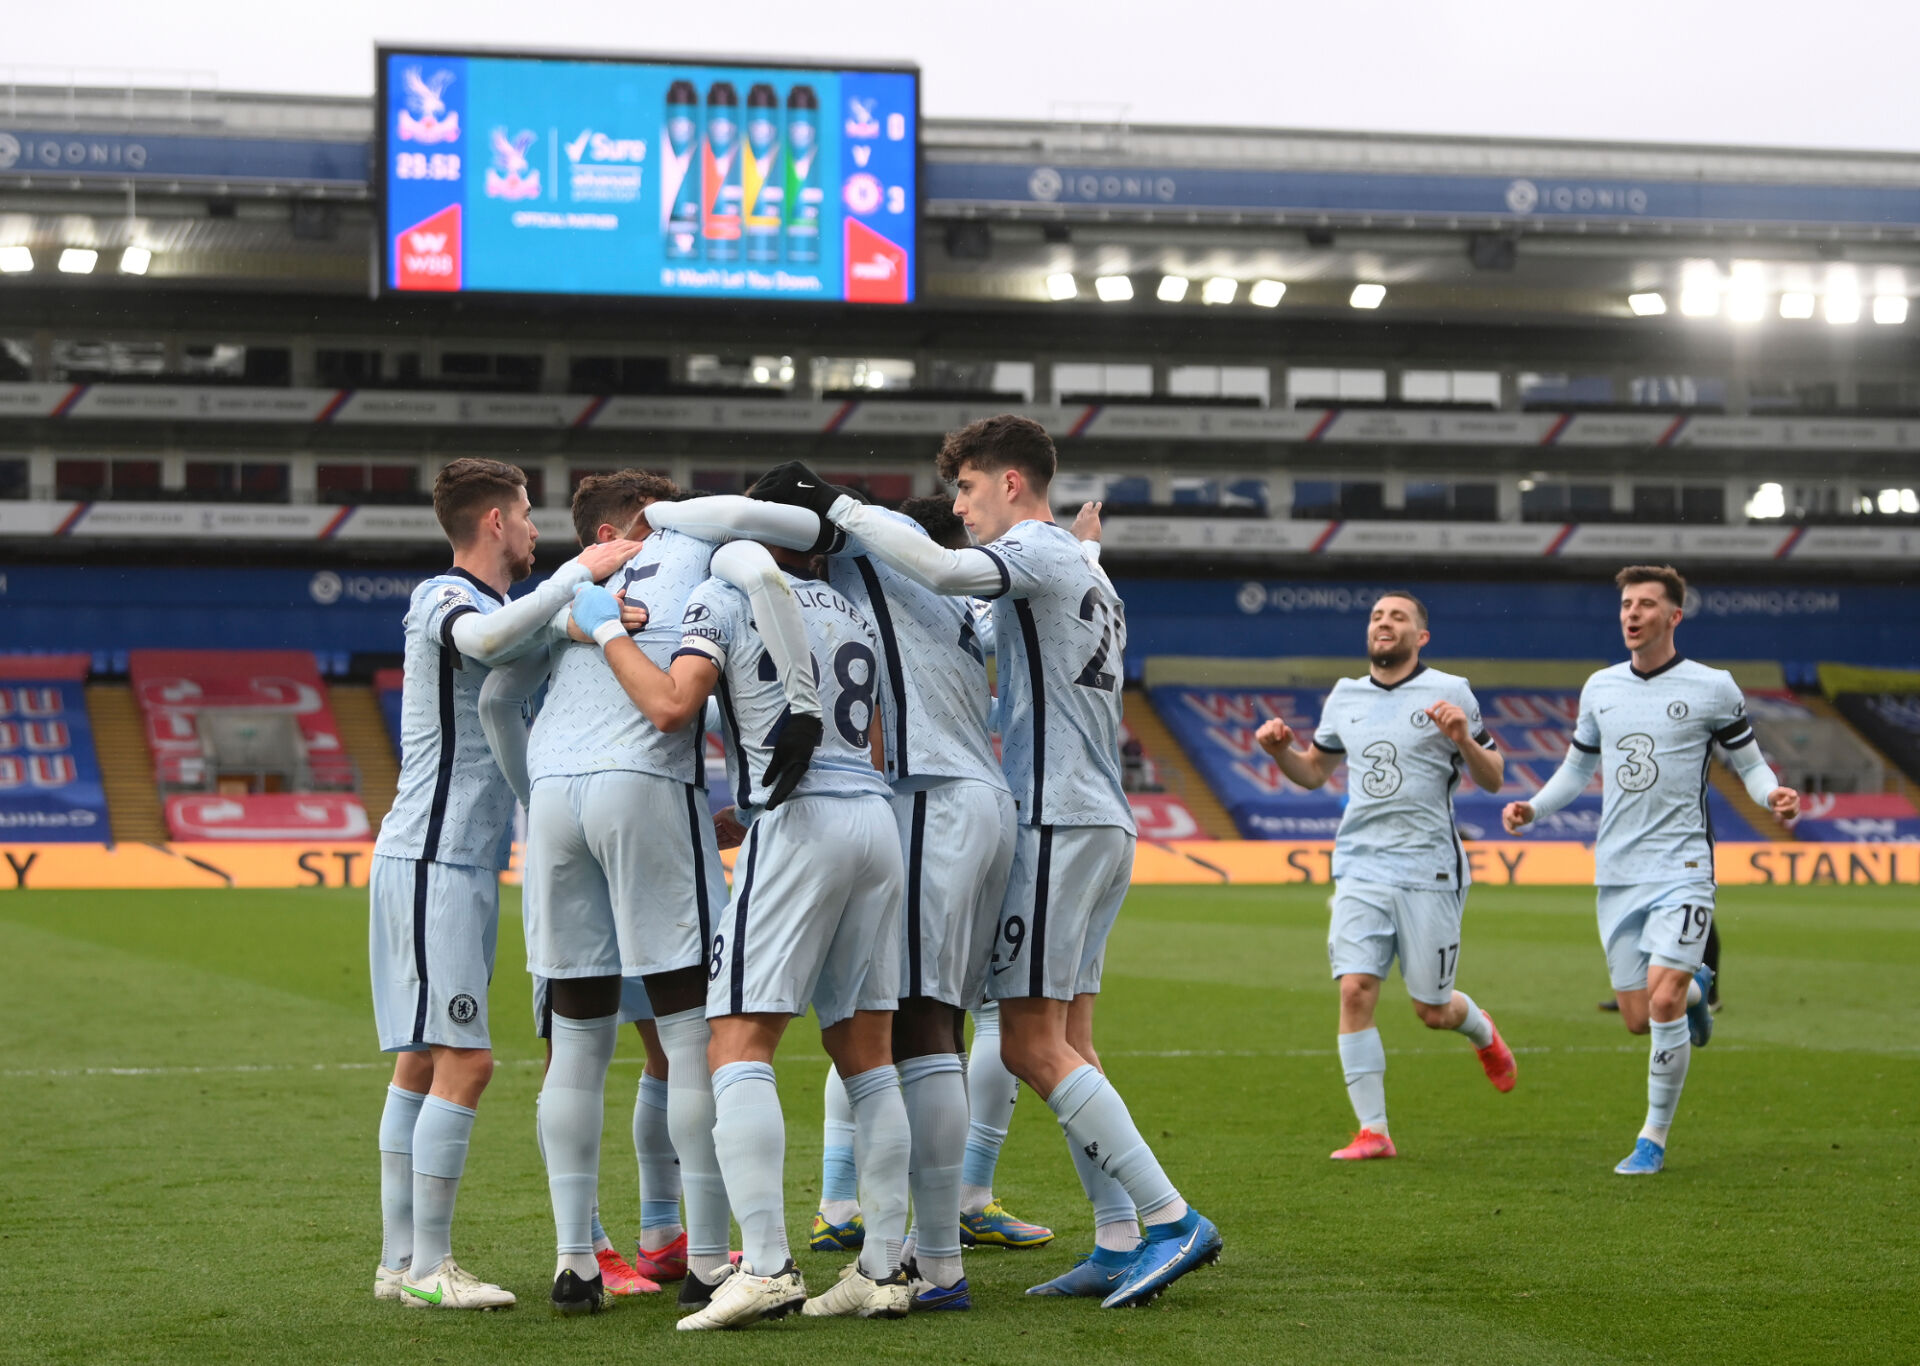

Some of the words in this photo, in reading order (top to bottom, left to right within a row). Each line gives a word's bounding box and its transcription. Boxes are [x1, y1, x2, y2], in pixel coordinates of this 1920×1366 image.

[25, 140, 147, 169] IQONIQ
[887, 186, 905, 214] 3
[1065, 175, 1176, 202] IQONIQ
[1541, 187, 1648, 214] IQONIQ
[1272, 586, 1384, 613] IQONIQ.C
[1362, 740, 1402, 799] 3
[1616, 732, 1659, 793] 3
[4, 853, 37, 886] Y
[298, 851, 371, 886] ST
[1750, 851, 1920, 886] STAN
[1681, 904, 1708, 940] 19
[1438, 943, 1459, 979] 17
